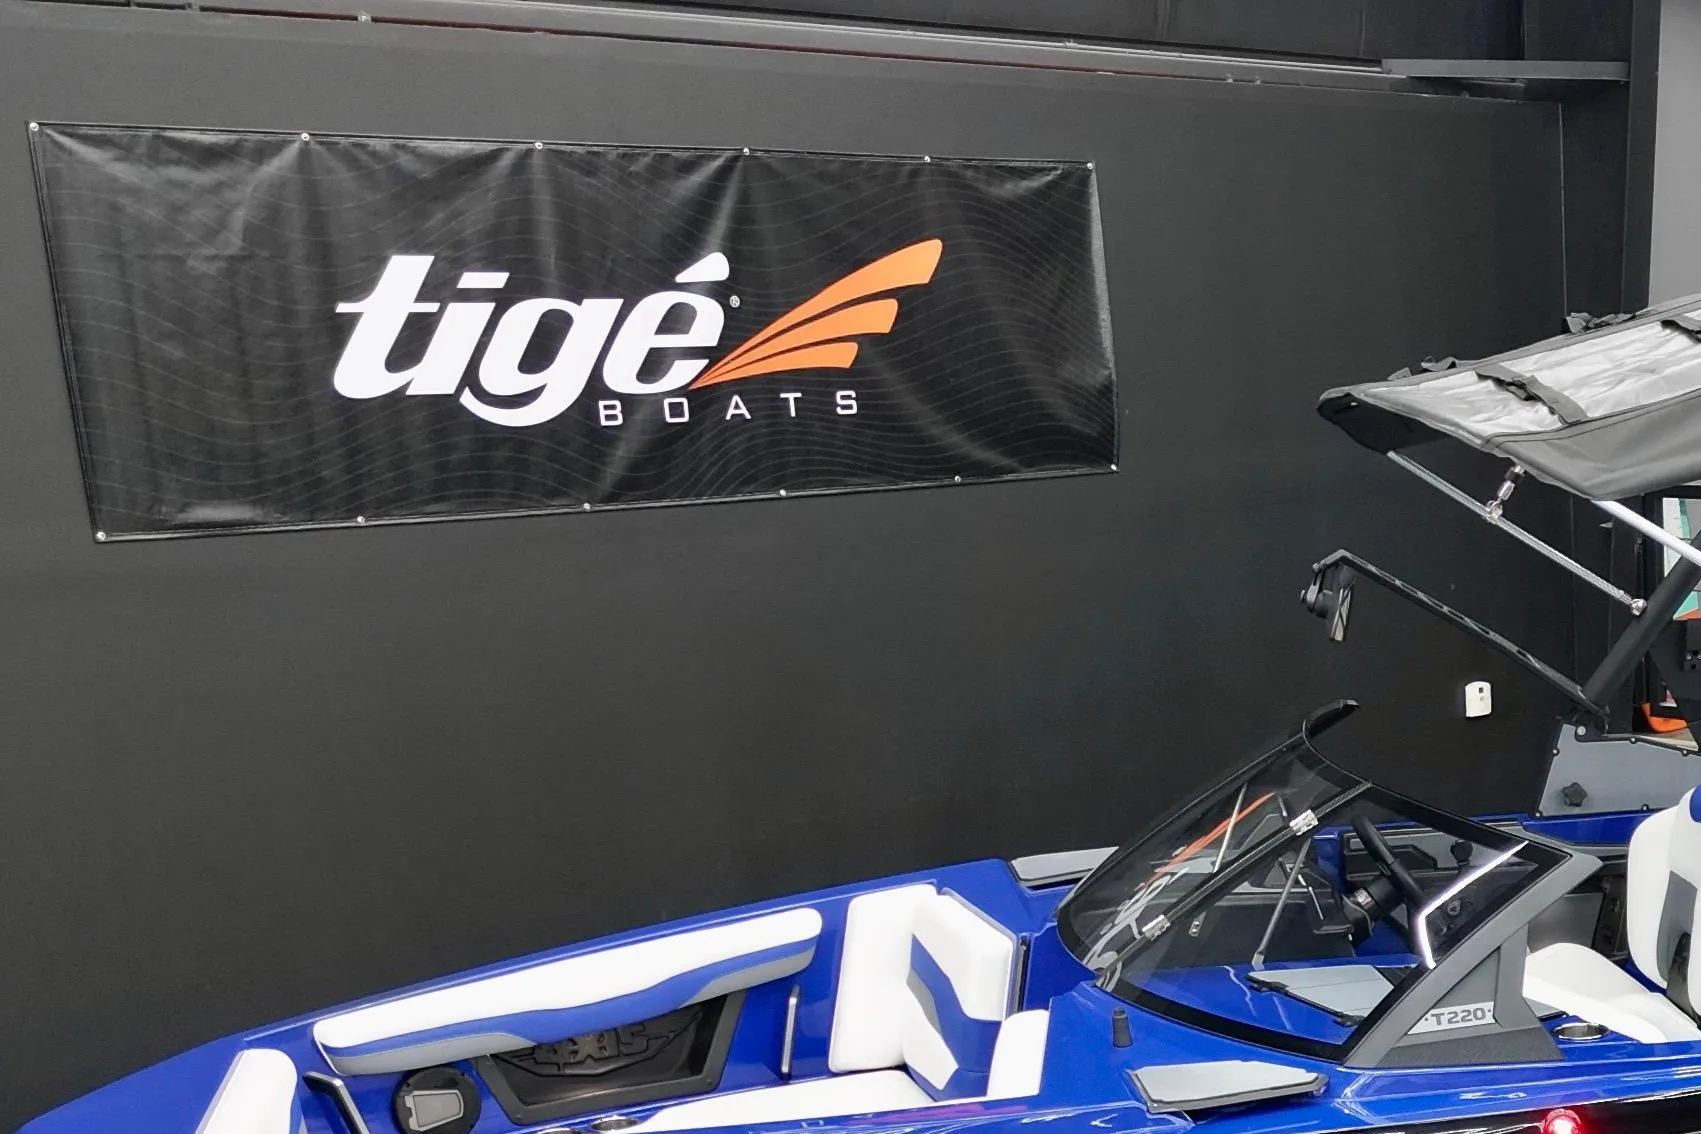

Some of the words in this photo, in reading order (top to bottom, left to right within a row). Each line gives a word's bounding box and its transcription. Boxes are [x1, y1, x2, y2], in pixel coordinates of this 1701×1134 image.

[333, 251, 731, 427] tigé
[598, 389, 858, 427] BOATS
[1430, 1007, 1487, 1026] T220
